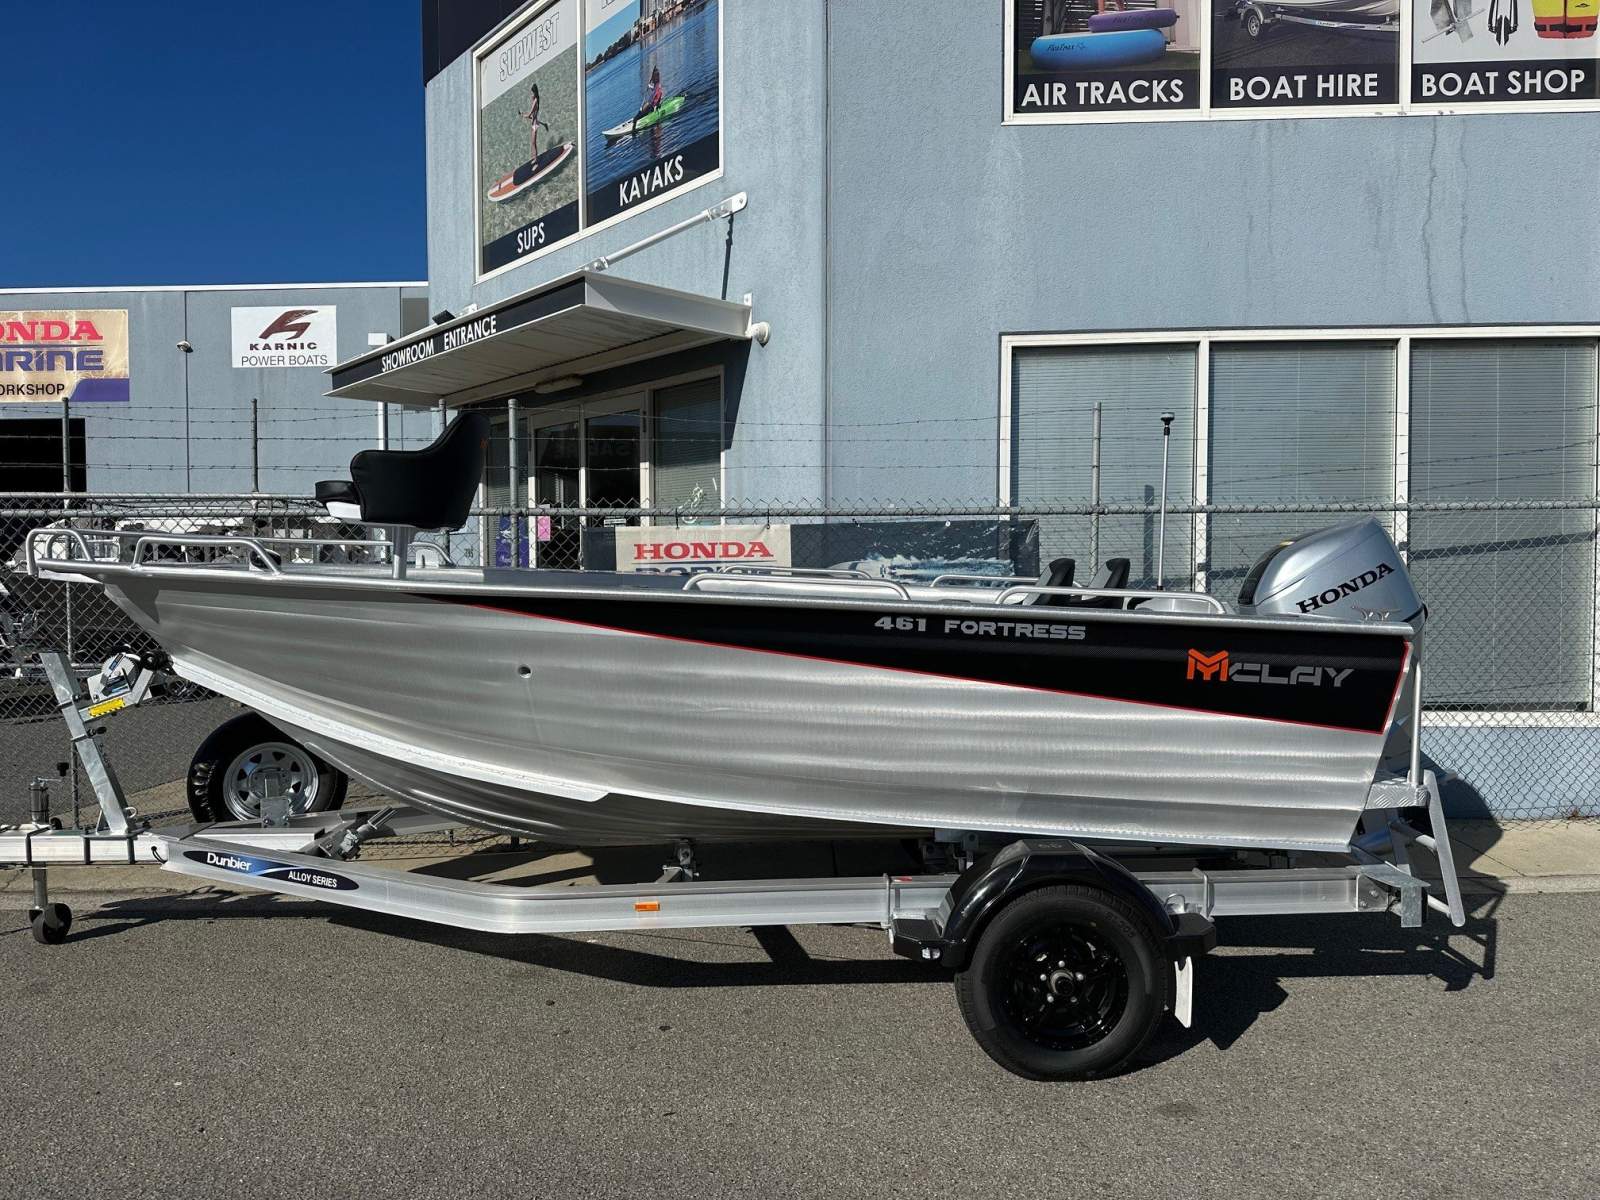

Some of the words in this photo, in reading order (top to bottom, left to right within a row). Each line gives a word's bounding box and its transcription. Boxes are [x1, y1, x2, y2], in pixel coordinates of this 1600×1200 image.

[499, 13, 560, 82] SUPWEST
[1021, 82, 1066, 107] AIR
[1076, 79, 1184, 105] TRACKS
[1229, 74, 1307, 101] BOAT
[1315, 72, 1378, 98] HIRE
[1421, 71, 1498, 97] BOAT
[1507, 69, 1585, 95] SHOP
[619, 155, 684, 207] KAYAKS
[516, 222, 545, 254] SUPS
[0, 321, 103, 341] NDA
[381, 338, 435, 373] SHOWROOM
[443, 315, 497, 350] ENTRANCE
[241, 355, 285, 366] POWER
[289, 354, 328, 366] BOATS
[249, 342, 318, 351] KARNIC
[633, 541, 774, 560] HONDA
[1296, 562, 1395, 613] HONDA
[874, 616, 927, 632] 461
[944, 619, 1086, 640] FORTRESS
[206, 852, 252, 871] Dunbier
[288, 871, 312, 884] ALLOY
[312, 874, 338, 888] SERIES
